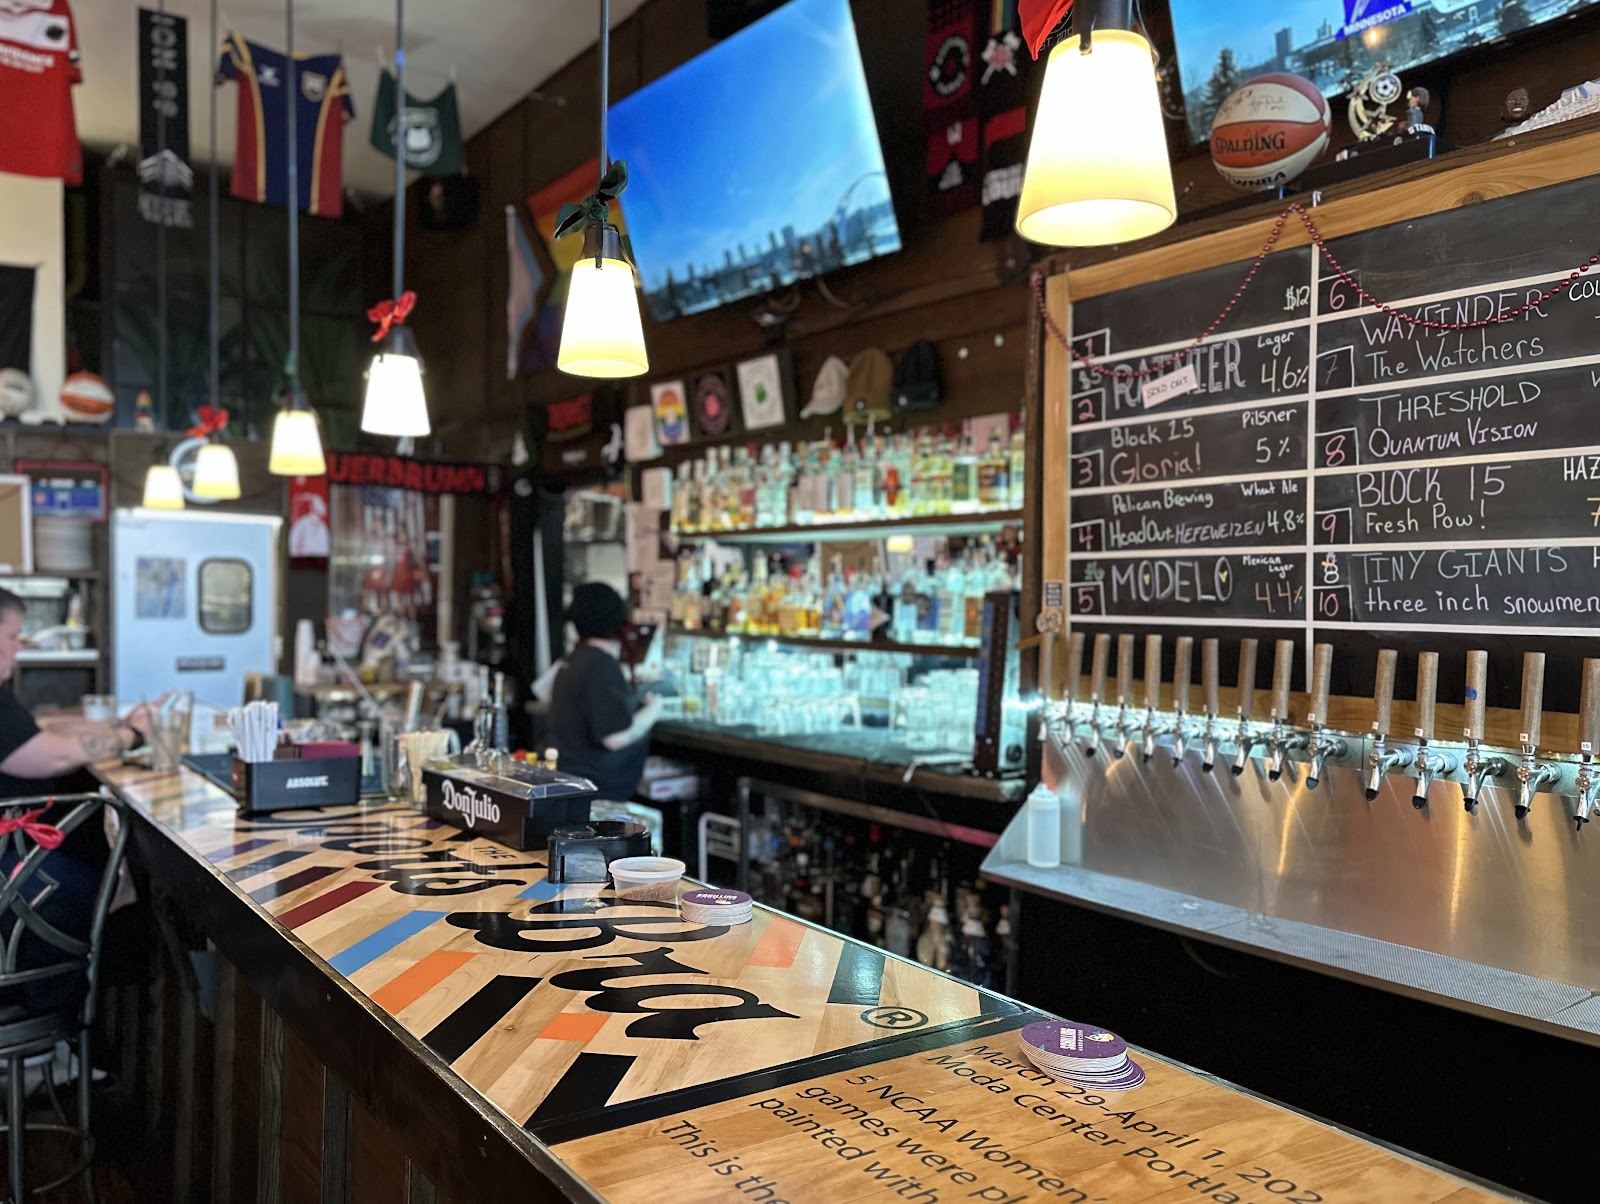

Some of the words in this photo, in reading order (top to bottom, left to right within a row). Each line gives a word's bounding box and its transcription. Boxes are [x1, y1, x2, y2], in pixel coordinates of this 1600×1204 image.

[1344, 4, 1406, 35] MINNESOTA
[1214, 131, 1285, 154] SPALDING
[1283, 286, 1310, 311] $12
[1329, 279, 1346, 310] 6
[1360, 288, 1548, 346] WAYFINDER
[1257, 331, 1294, 356] Lager
[1365, 350, 1408, 379] The
[1416, 328, 1544, 372] Watchers
[1261, 356, 1309, 394] 4.6%
[1324, 354, 1338, 385] 7
[1146, 384, 1168, 399] SOLD
[1170, 376, 1188, 389] OUT
[1077, 398, 1096, 421] 2
[1242, 408, 1297, 429] Pilsner
[1359, 381, 1541, 428] THRESHOLD
[1111, 424, 1162, 449] Block
[1168, 418, 1195, 441] 15
[1368, 427, 1460, 458] QUANTUM
[1467, 417, 1538, 447] VISION
[1110, 441, 1201, 486] Gloria!
[1325, 435, 1345, 467] 8
[1078, 457, 1094, 484] 3
[1241, 482, 1275, 497] Wheat
[1282, 478, 1299, 494] Ale
[1356, 467, 1443, 508] BLOCK
[1470, 465, 1511, 501] 15
[1112, 493, 1161, 516] Pelican
[1267, 509, 1305, 534] 4.8%
[1321, 513, 1337, 543] 9
[1366, 508, 1419, 534] Fresh
[1078, 525, 1094, 552] 4
[1243, 556, 1281, 566] Mexican
[1269, 563, 1294, 579] Lager
[1352, 549, 1426, 585] TINY
[1437, 546, 1568, 580] GIANTS
[1112, 556, 1233, 603] MODELO
[1077, 587, 1094, 613] 5
[1255, 580, 1303, 613] 4.4%
[1319, 591, 1339, 617] 10
[1365, 586, 1428, 612] three
[1436, 583, 1490, 612] inch
[846, 1074, 878, 1086] 5
[867, 1085, 958, 1133] NCAA
[927, 1054, 1010, 1094] Moda
[1014, 1094, 1126, 1147] Center
[749, 1097, 876, 1161] painted
[862, 1160, 940, 1204] with
[795, 1086, 899, 1137] games
[897, 1137, 977, 1184] were
[660, 1120, 719, 1158] This
[708, 1156, 743, 1176] is
[734, 1175, 790, 1204] the
[1201, 1148, 1226, 1168] 1,
